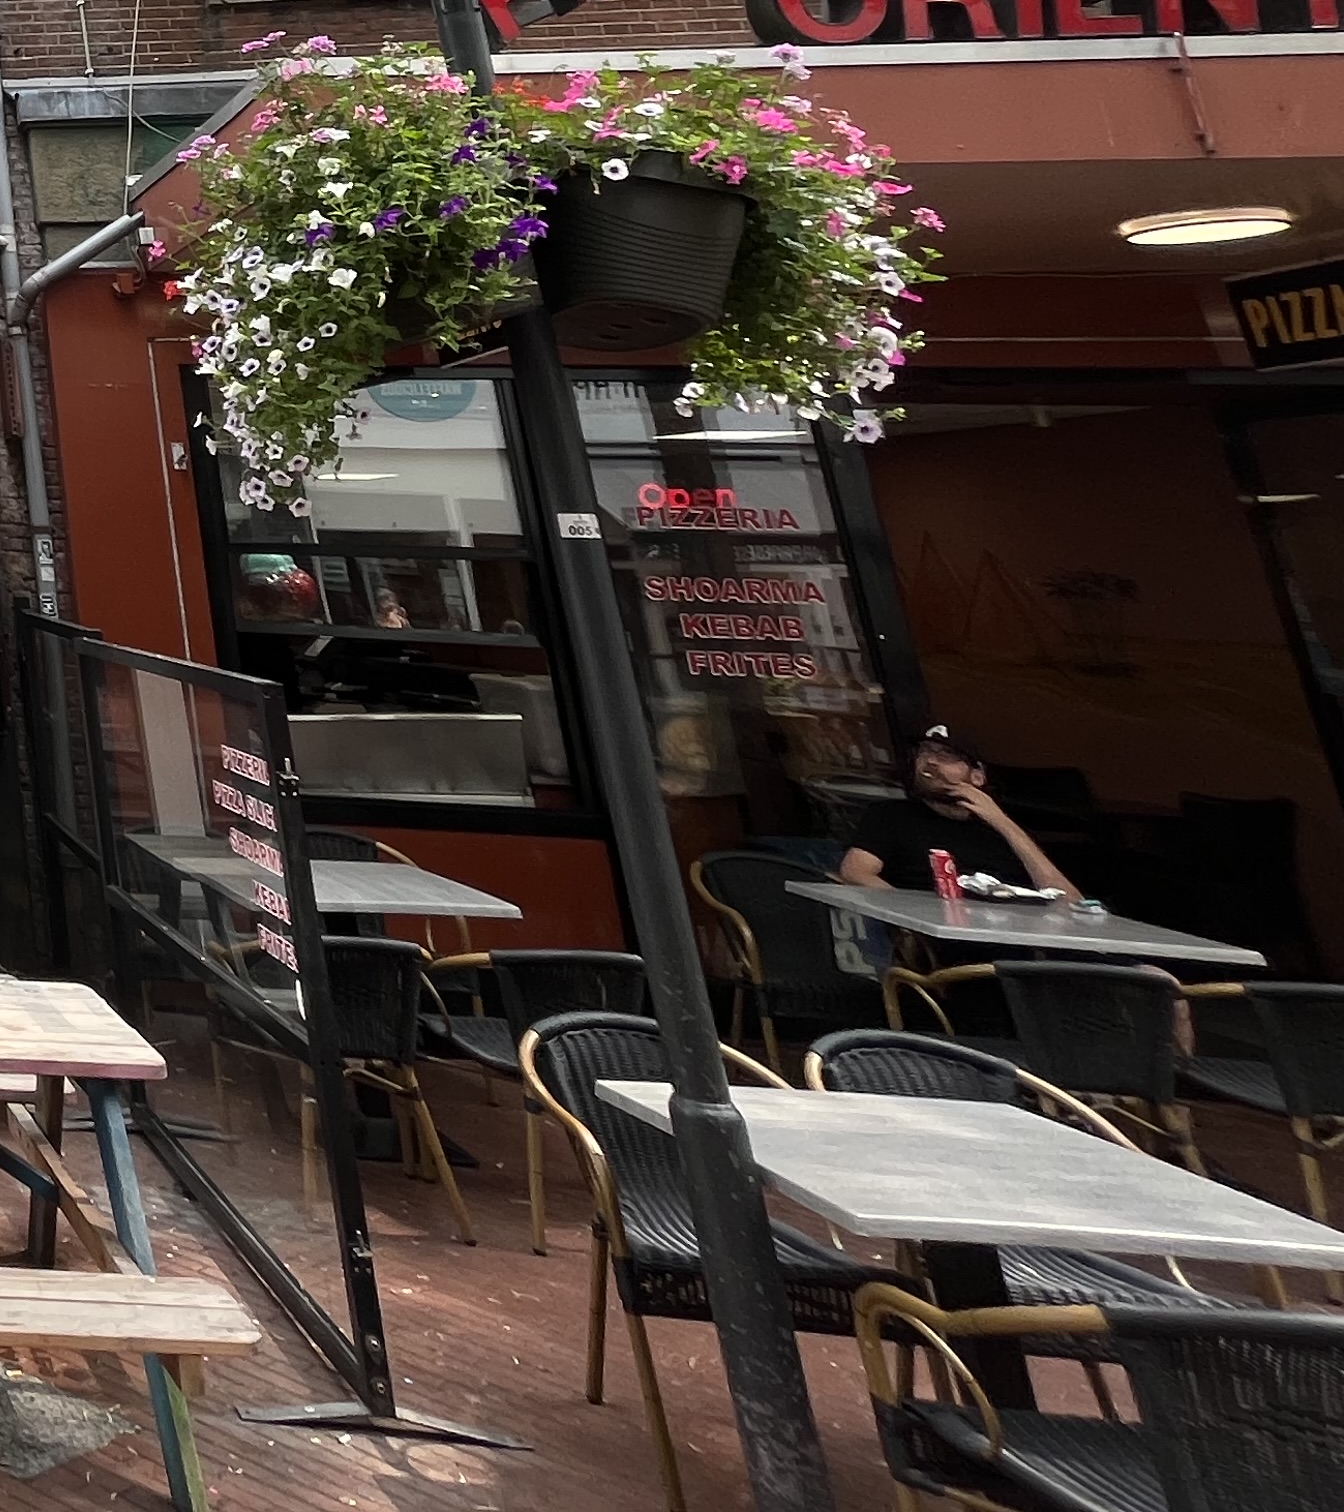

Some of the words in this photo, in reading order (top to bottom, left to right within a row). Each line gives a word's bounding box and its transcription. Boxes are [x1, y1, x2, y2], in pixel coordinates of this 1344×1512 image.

[637, 482, 737, 510] Open
[635, 507, 800, 532] PIZZERIA
[644, 575, 826, 604] SHOARMA
[679, 612, 805, 641] KEBAB
[685, 650, 817, 678] FRITES
[229, 826, 285, 879] SHOARM
